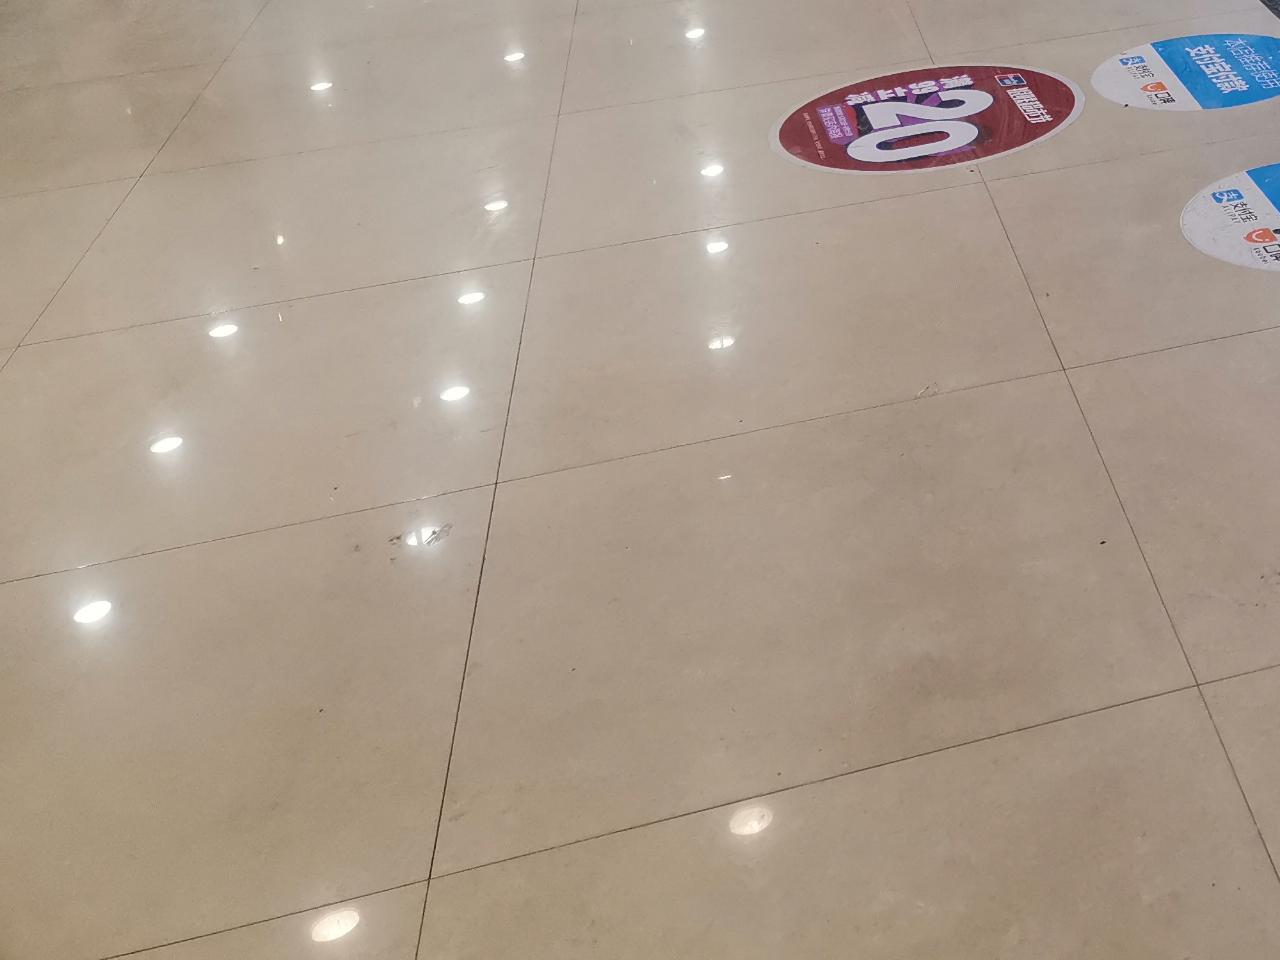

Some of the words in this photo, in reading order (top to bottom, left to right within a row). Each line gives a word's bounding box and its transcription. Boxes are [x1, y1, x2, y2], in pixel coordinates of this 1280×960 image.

[1185, 44, 1250, 94] 支付宝付款
[847, 89, 994, 163] 20
[1229, 201, 1260, 224] 支付宝
